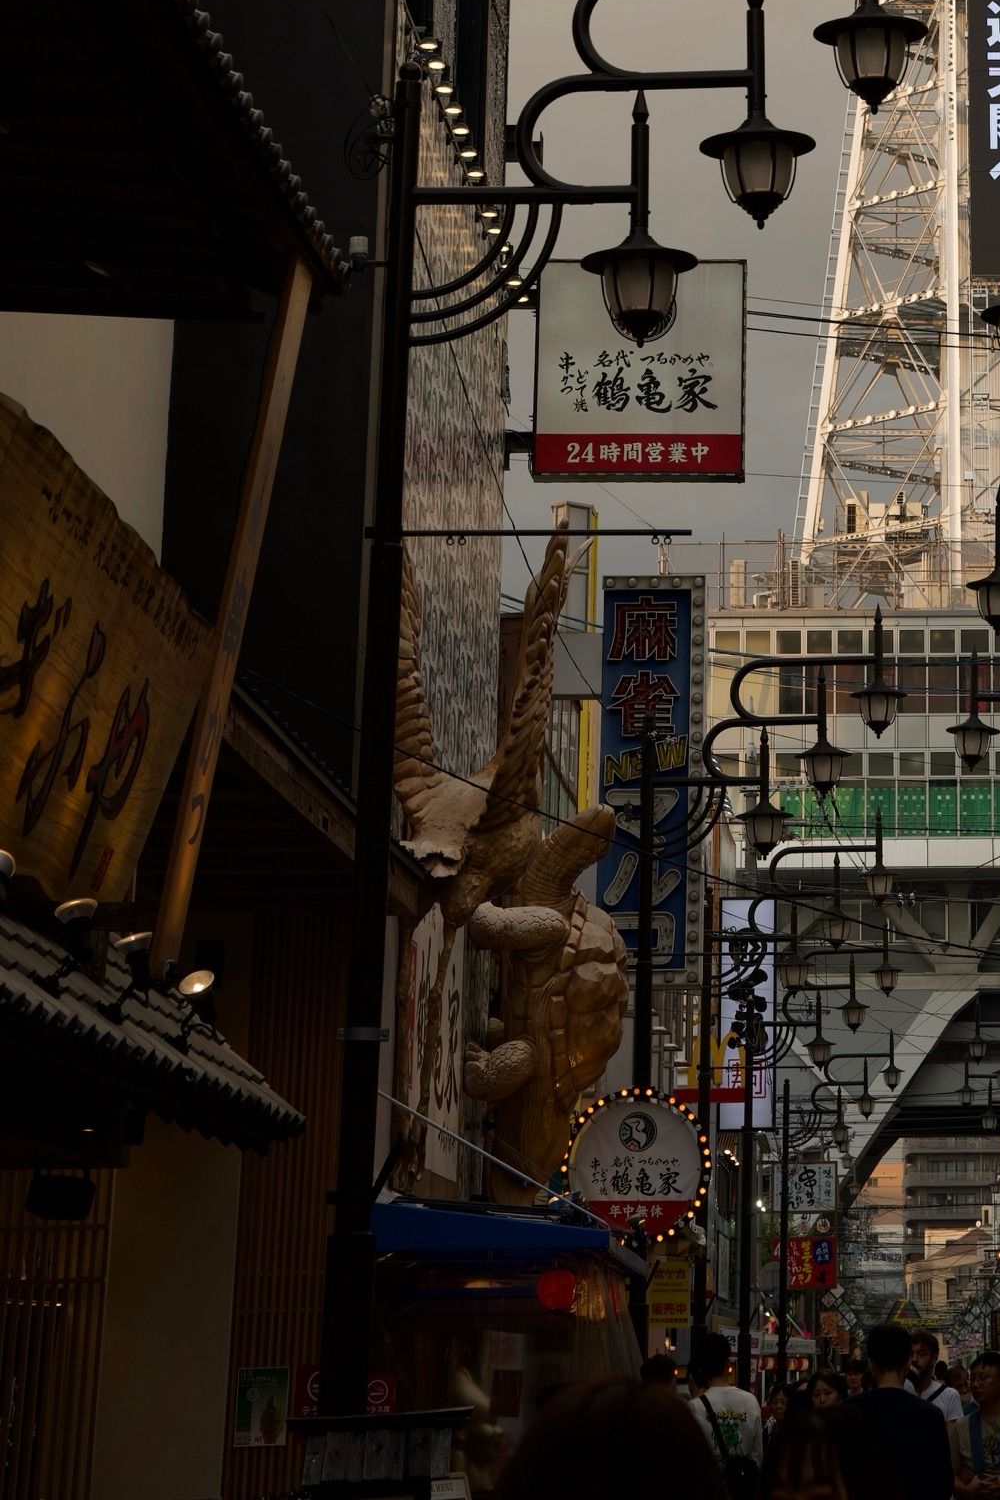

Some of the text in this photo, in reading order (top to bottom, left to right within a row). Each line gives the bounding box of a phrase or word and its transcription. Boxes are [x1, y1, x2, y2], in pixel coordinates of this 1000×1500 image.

[593, 350, 634, 368] 名代
[591, 367, 718, 413] 鶴亀家
[566, 442, 710, 464] 24時間営業中
[606, 595, 680, 737] 麻雀
[604, 734, 688, 786] NEW
[611, 1167, 683, 1197] 鶴亀家
[608, 1204, 664, 1218] 年中無休
